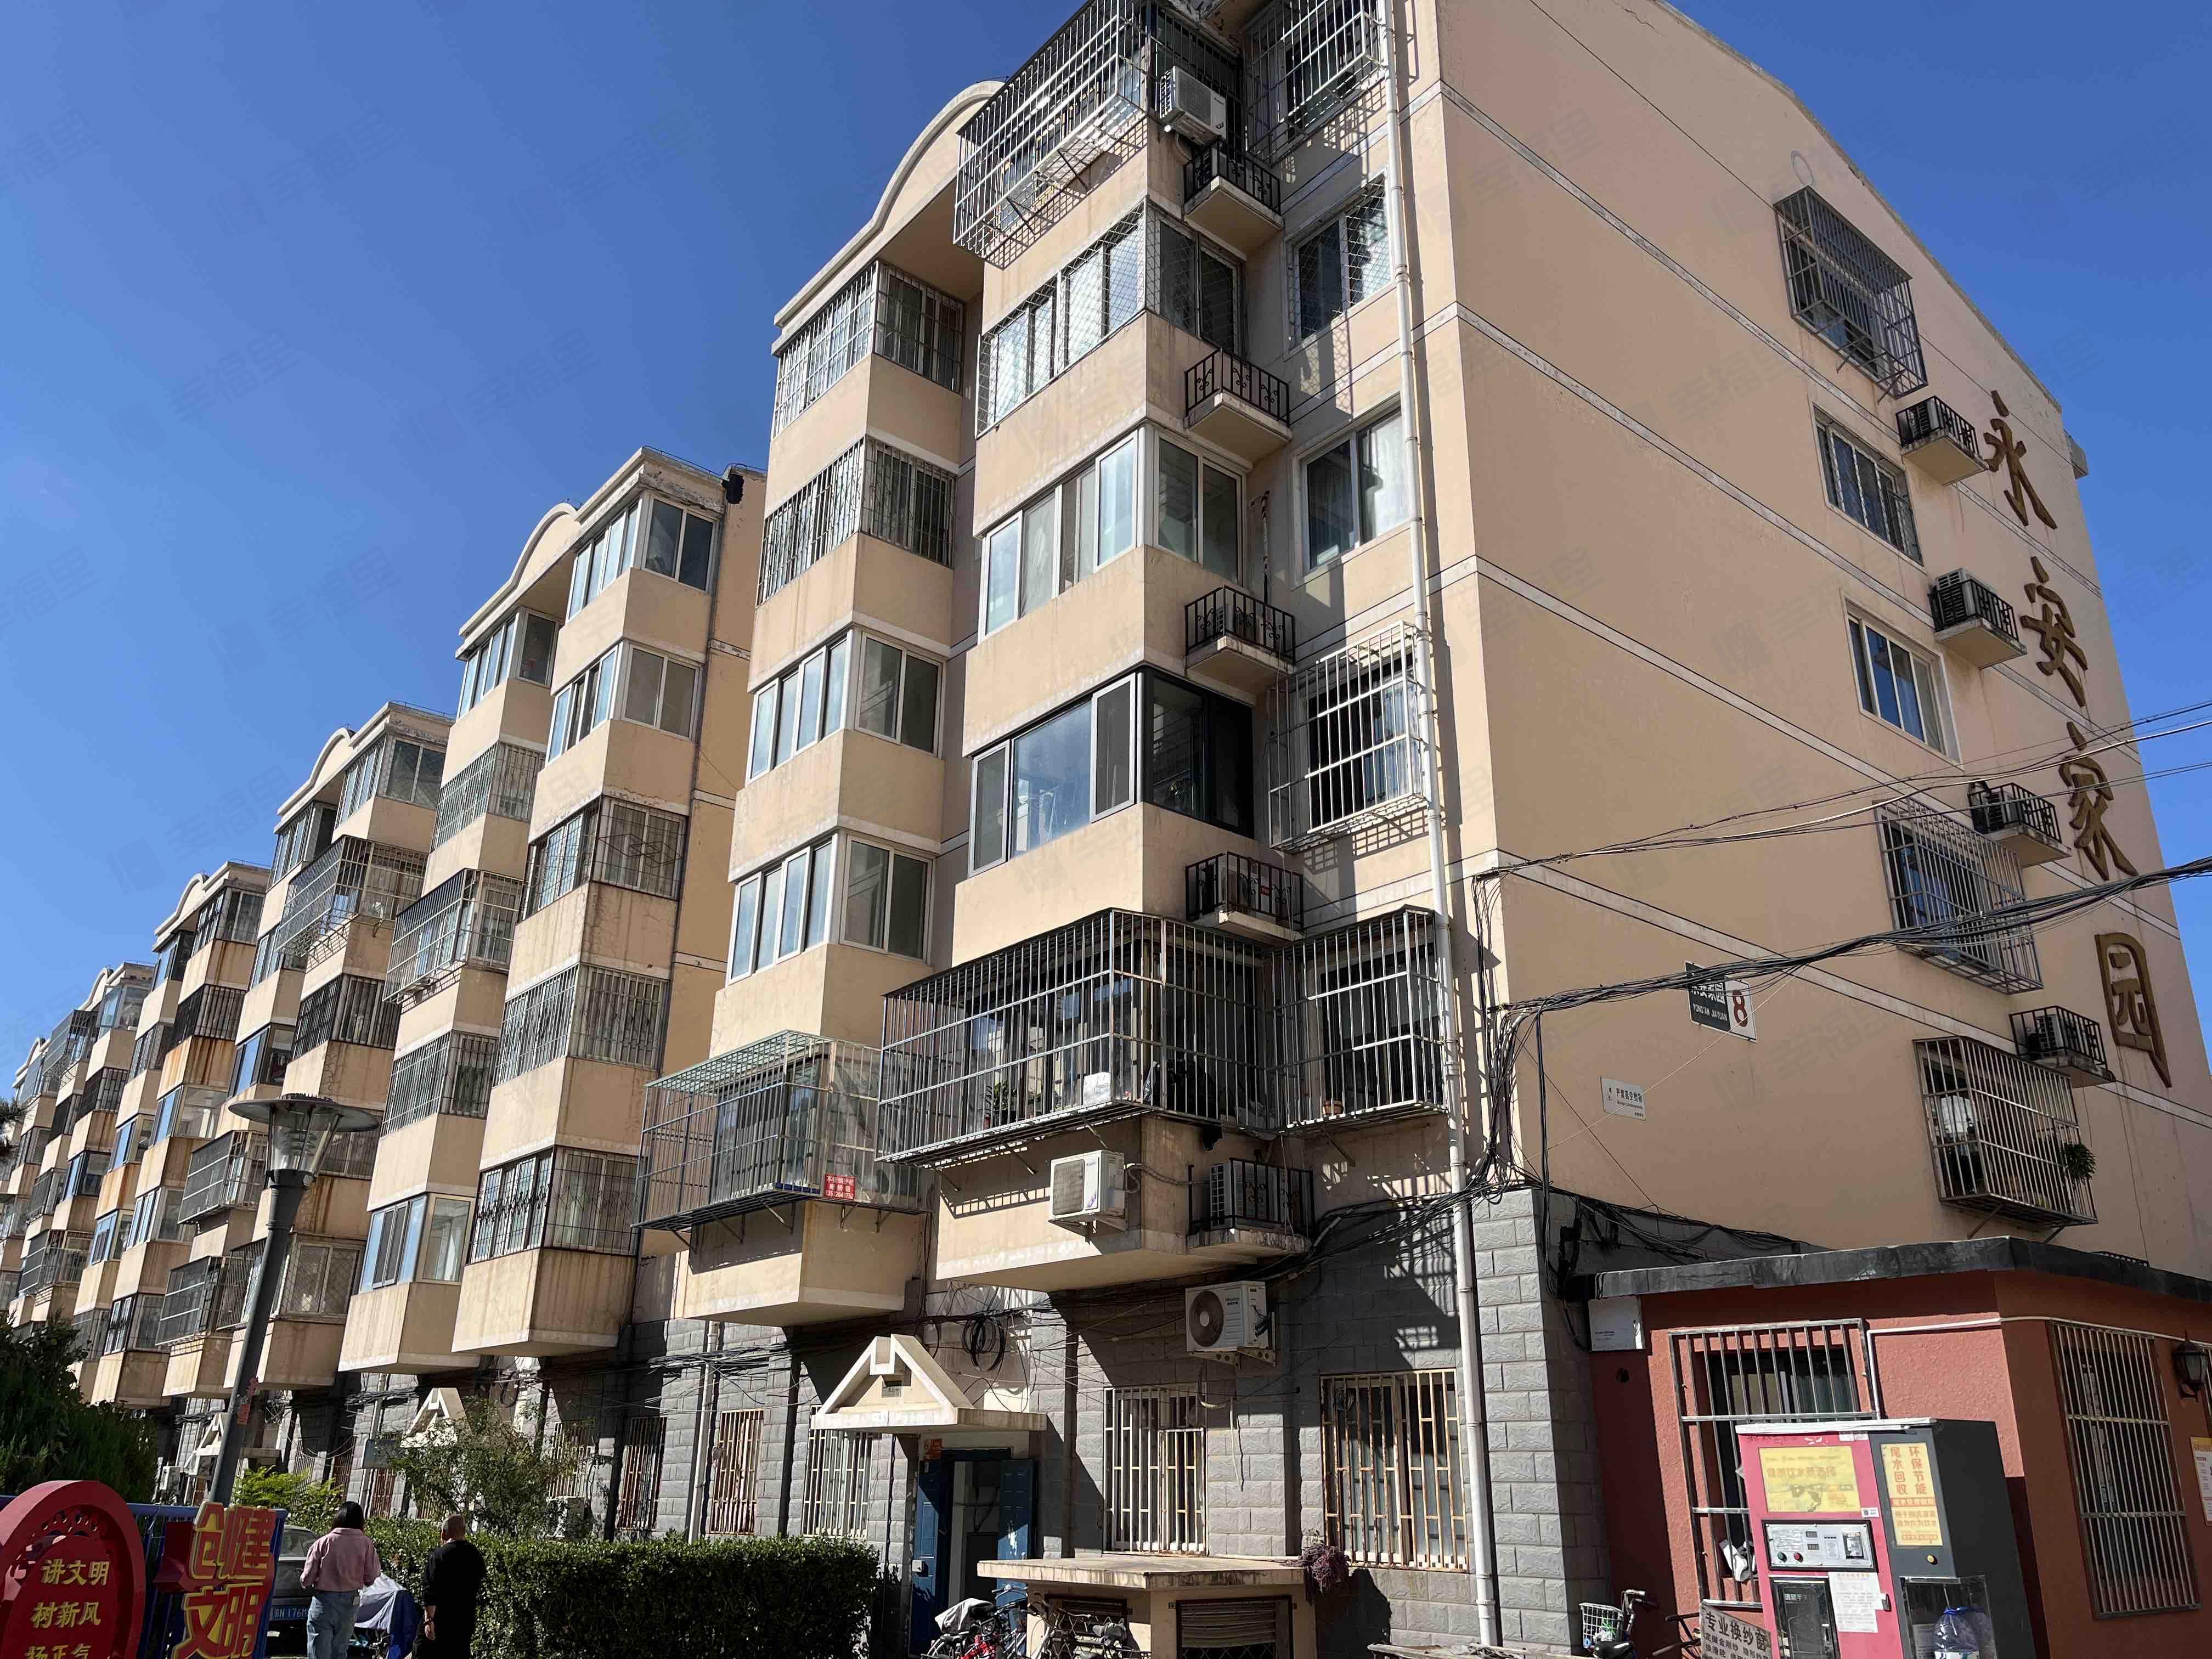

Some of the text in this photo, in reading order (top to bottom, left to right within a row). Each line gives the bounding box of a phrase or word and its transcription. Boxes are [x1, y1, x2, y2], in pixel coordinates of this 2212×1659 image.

[1984, 390, 2171, 1087] 永安家园
[1733, 989, 1748, 1028] 8
[1909, 1447, 1927, 1495] 环保节能
[42, 1559, 110, 1585] 讲文明
[31, 1601, 101, 1628] 树新风
[171, 1582, 269, 1659] 文明
[1706, 1611, 1766, 1652] 专业换纱窗
